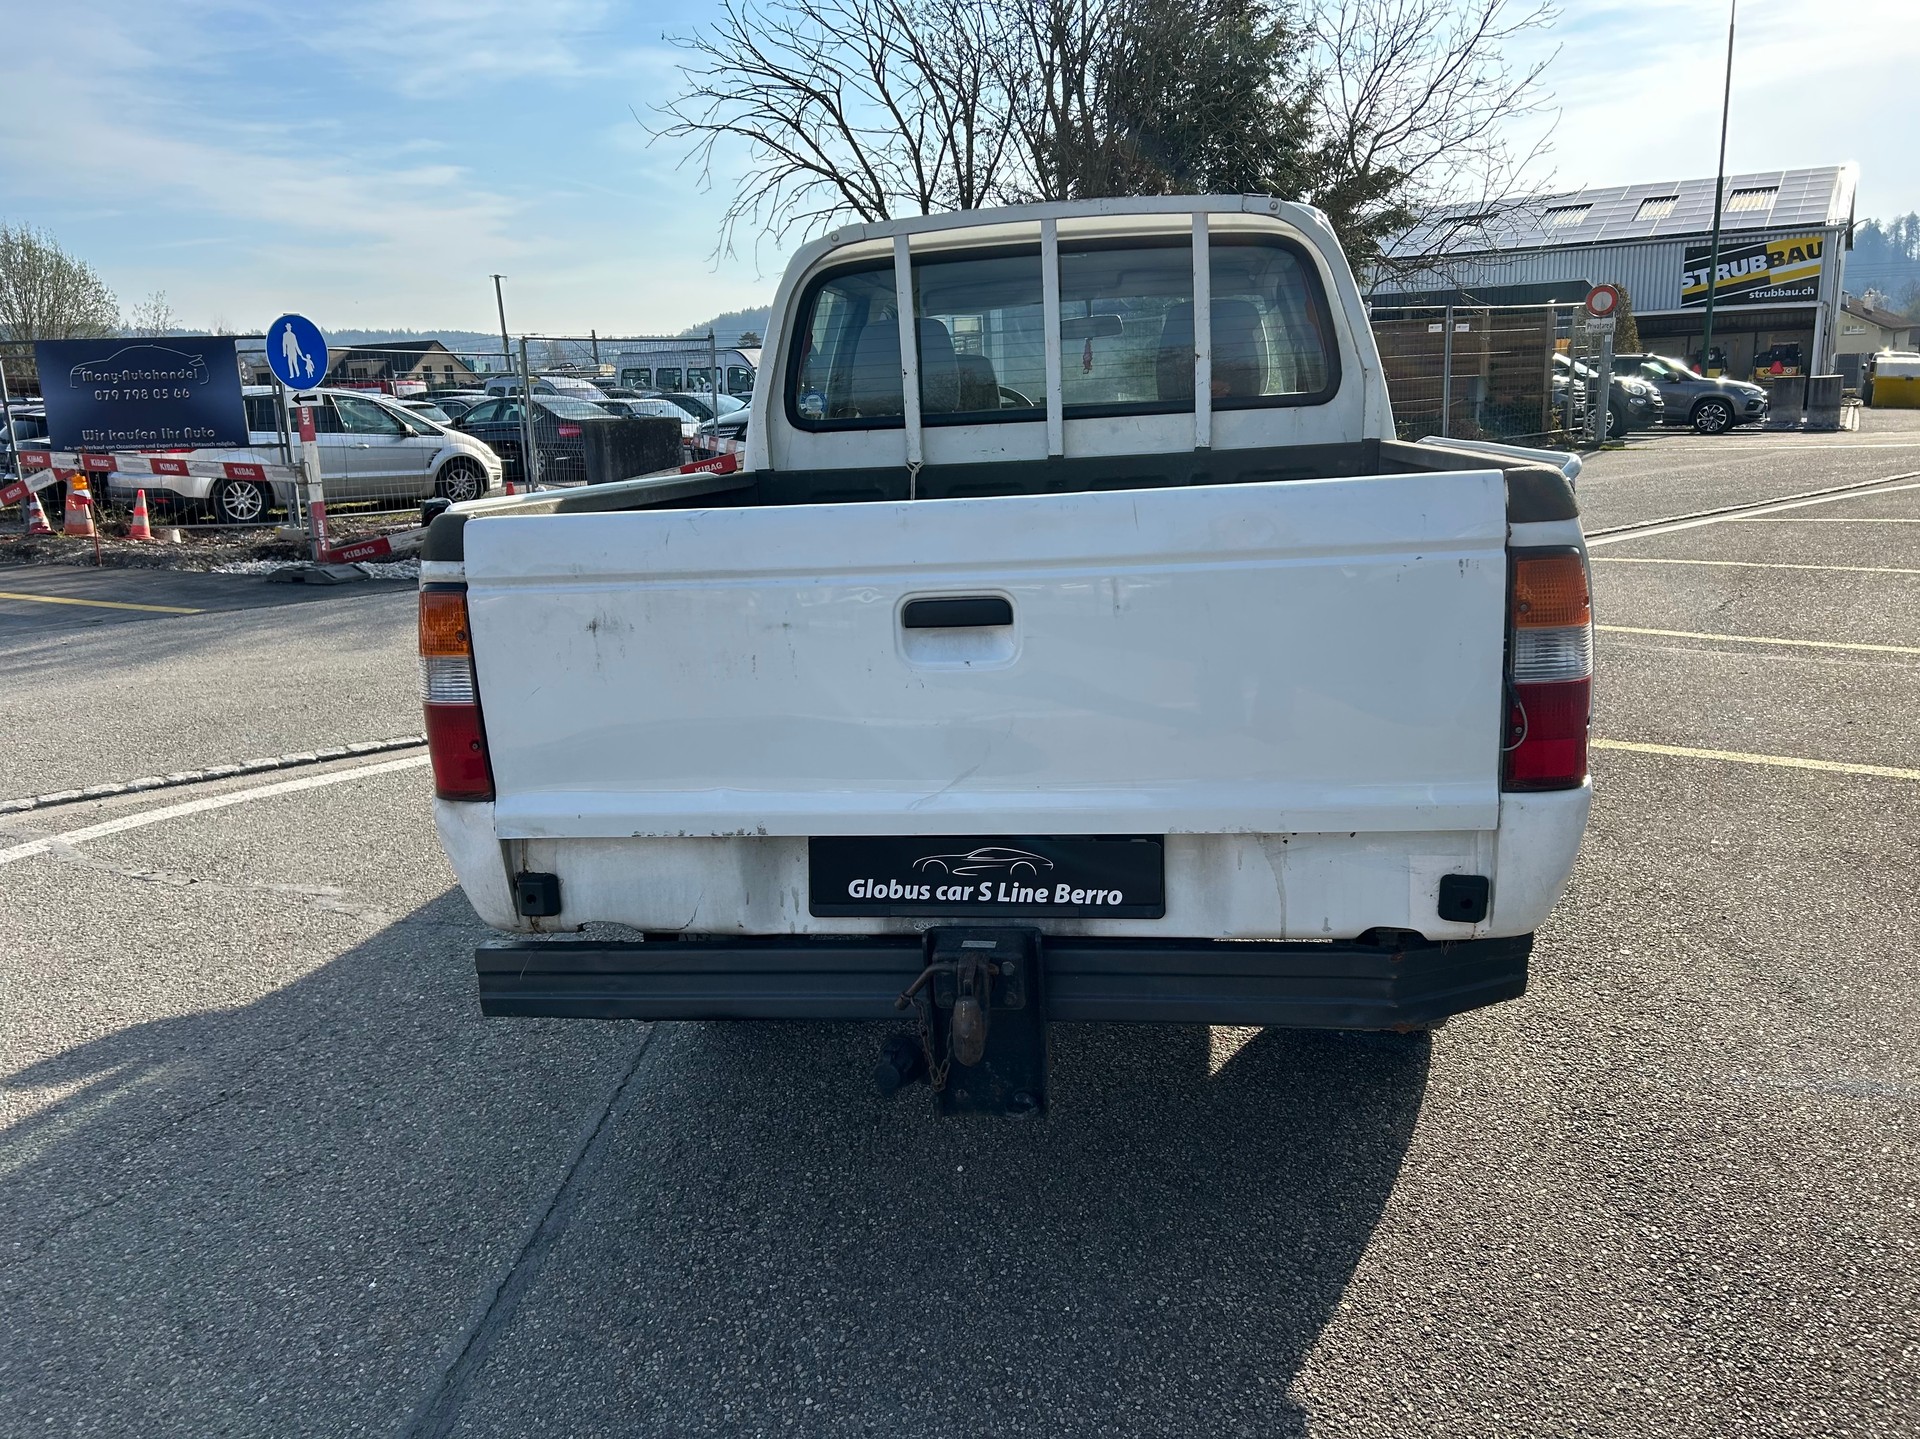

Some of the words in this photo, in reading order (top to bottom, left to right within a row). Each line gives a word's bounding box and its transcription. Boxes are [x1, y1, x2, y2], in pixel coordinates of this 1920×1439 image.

[1682, 240, 1823, 289] STRUBBAU
[1749, 286, 1815, 299] strubbau.ch
[82, 368, 198, 384] Mony-Autohandel
[94, 389, 119, 401] 079
[124, 388, 149, 400] 798
[153, 388, 169, 399] 05
[173, 387, 191, 399] 66
[302, 407, 310, 425] KIB
[82, 429, 105, 441] Wir
[108, 428, 157, 441] kaufen
[161, 427, 180, 439] Ihr
[184, 426, 216, 439] Auto
[27, 455, 44, 464] KIBAG
[90, 458, 110, 467] KIBAG
[159, 462, 180, 472] KIBAG
[233, 467, 256, 477] KIBAG
[694, 462, 723, 473] KIBAG
[342, 545, 376, 560] KIBAG
[848, 878, 930, 900] Globus
[935, 885, 974, 901] car
[977, 881, 992, 902] S
[997, 881, 1049, 903] Line
[1053, 883, 1123, 906] Berro
